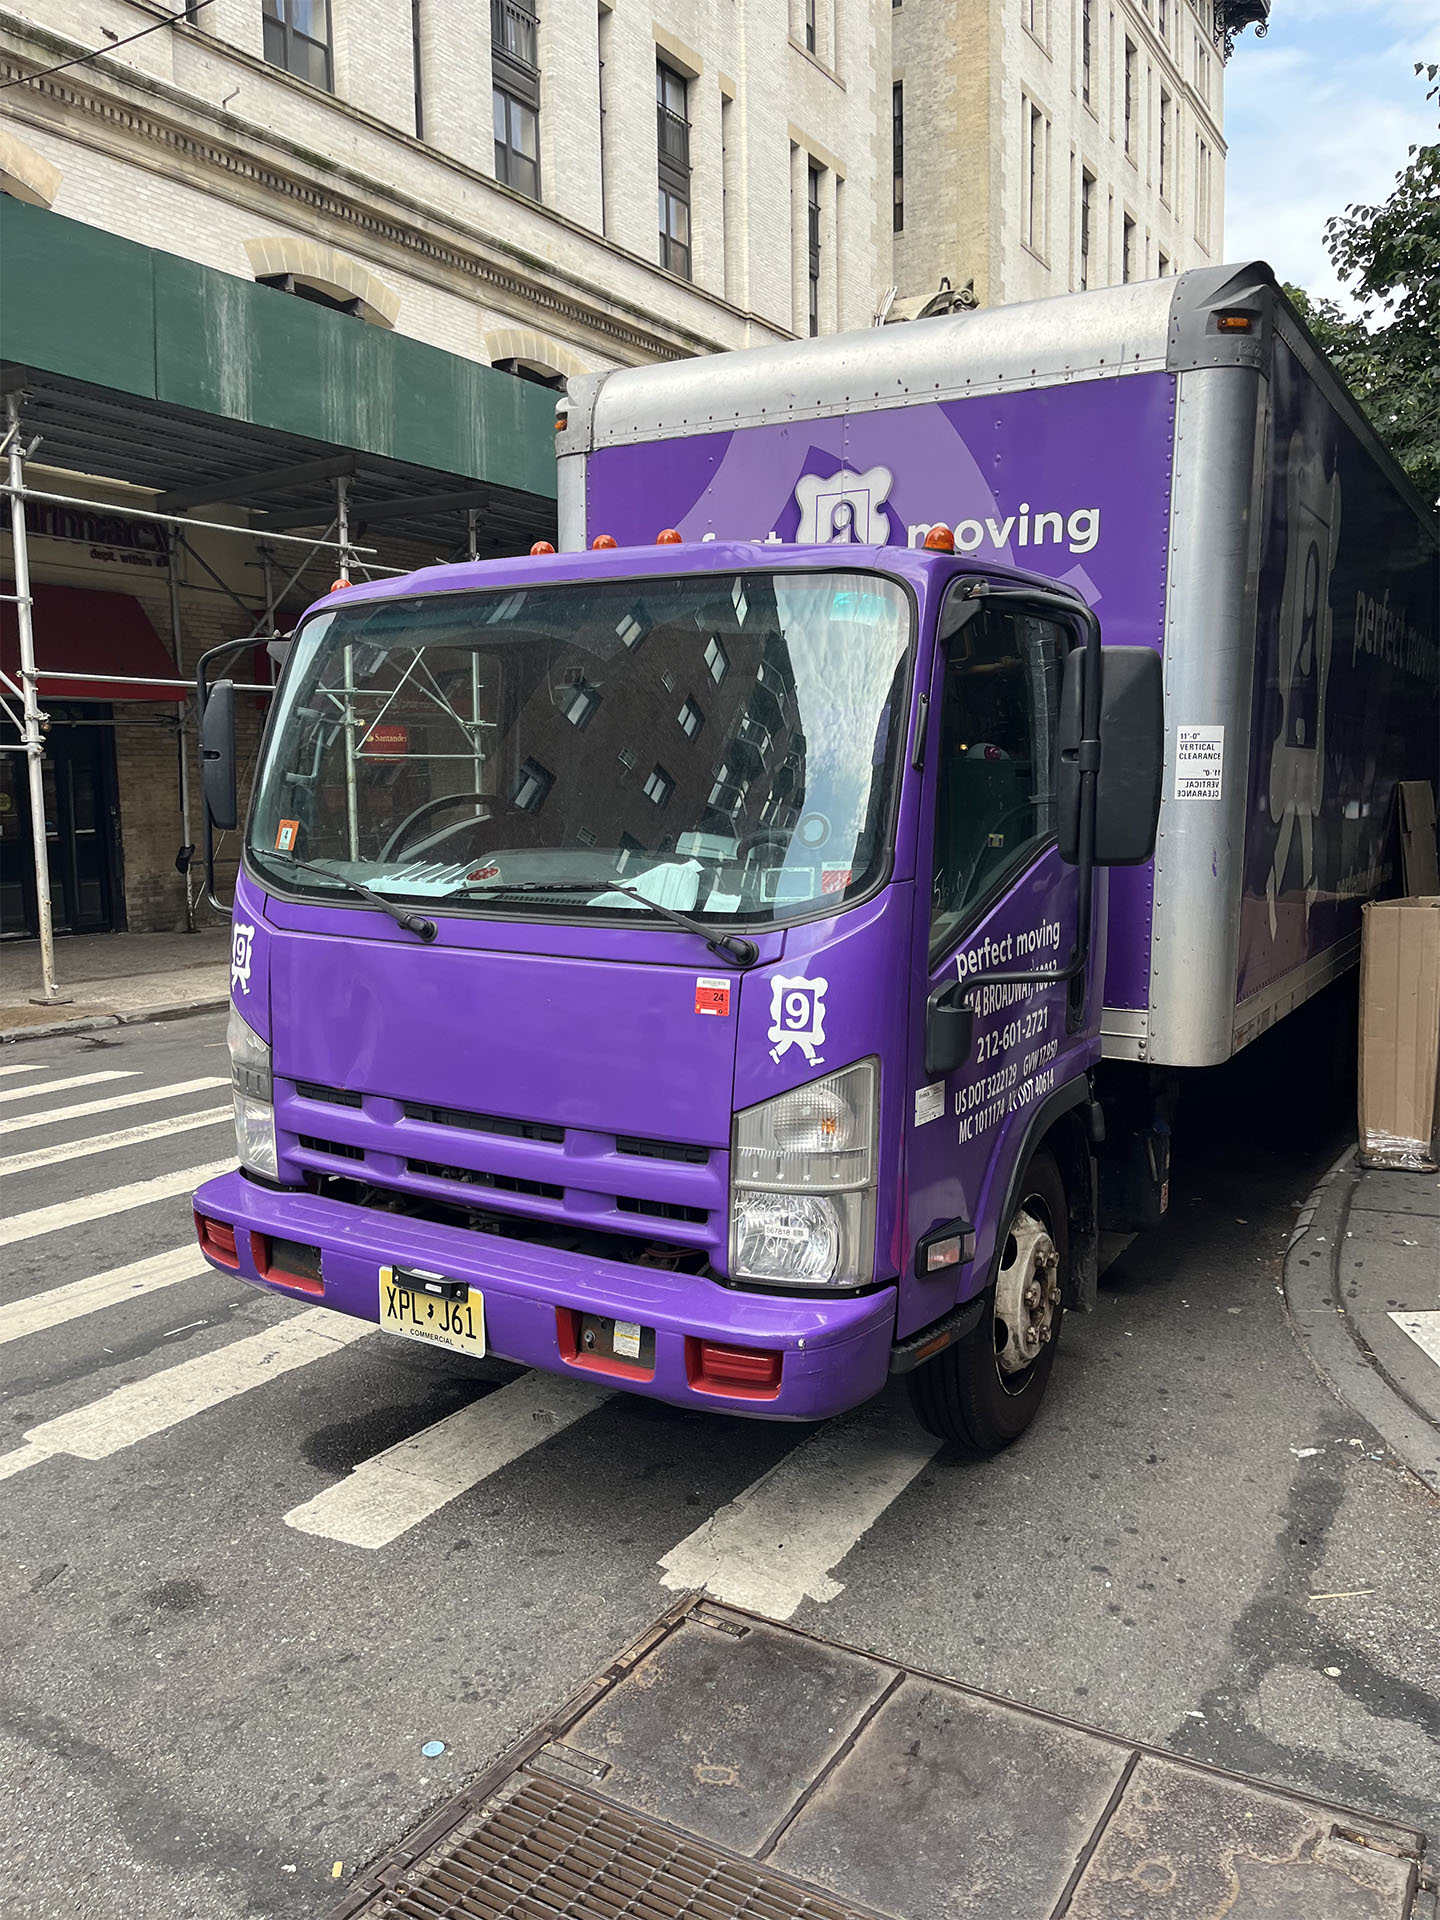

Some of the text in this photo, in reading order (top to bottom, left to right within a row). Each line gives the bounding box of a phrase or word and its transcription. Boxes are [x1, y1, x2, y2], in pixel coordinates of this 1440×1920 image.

[907, 503, 1100, 553] moving
[375, 733, 407, 743] Santander
[1178, 752, 1221, 760] CLEARANCE
[1180, 743, 1215, 751] VERTICAL
[236, 936, 246, 966] 9
[955, 918, 1061, 984] perfect moving
[713, 992, 725, 1002] 24
[785, 992, 810, 1030] 9
[976, 1006, 1049, 1065] 212-601-2721
[954, 1088, 968, 1116] US
[968, 1078, 986, 1110] DOT
[986, 1062, 1018, 1100] 3222129
[1023, 1050, 1040, 1078] GVW
[958, 1115, 974, 1145] MC
[974, 1096, 1005, 1136] 1011174
[386, 1286, 477, 1340] XPL J61
[410, 1328, 455, 1346] COMMERCIAL
